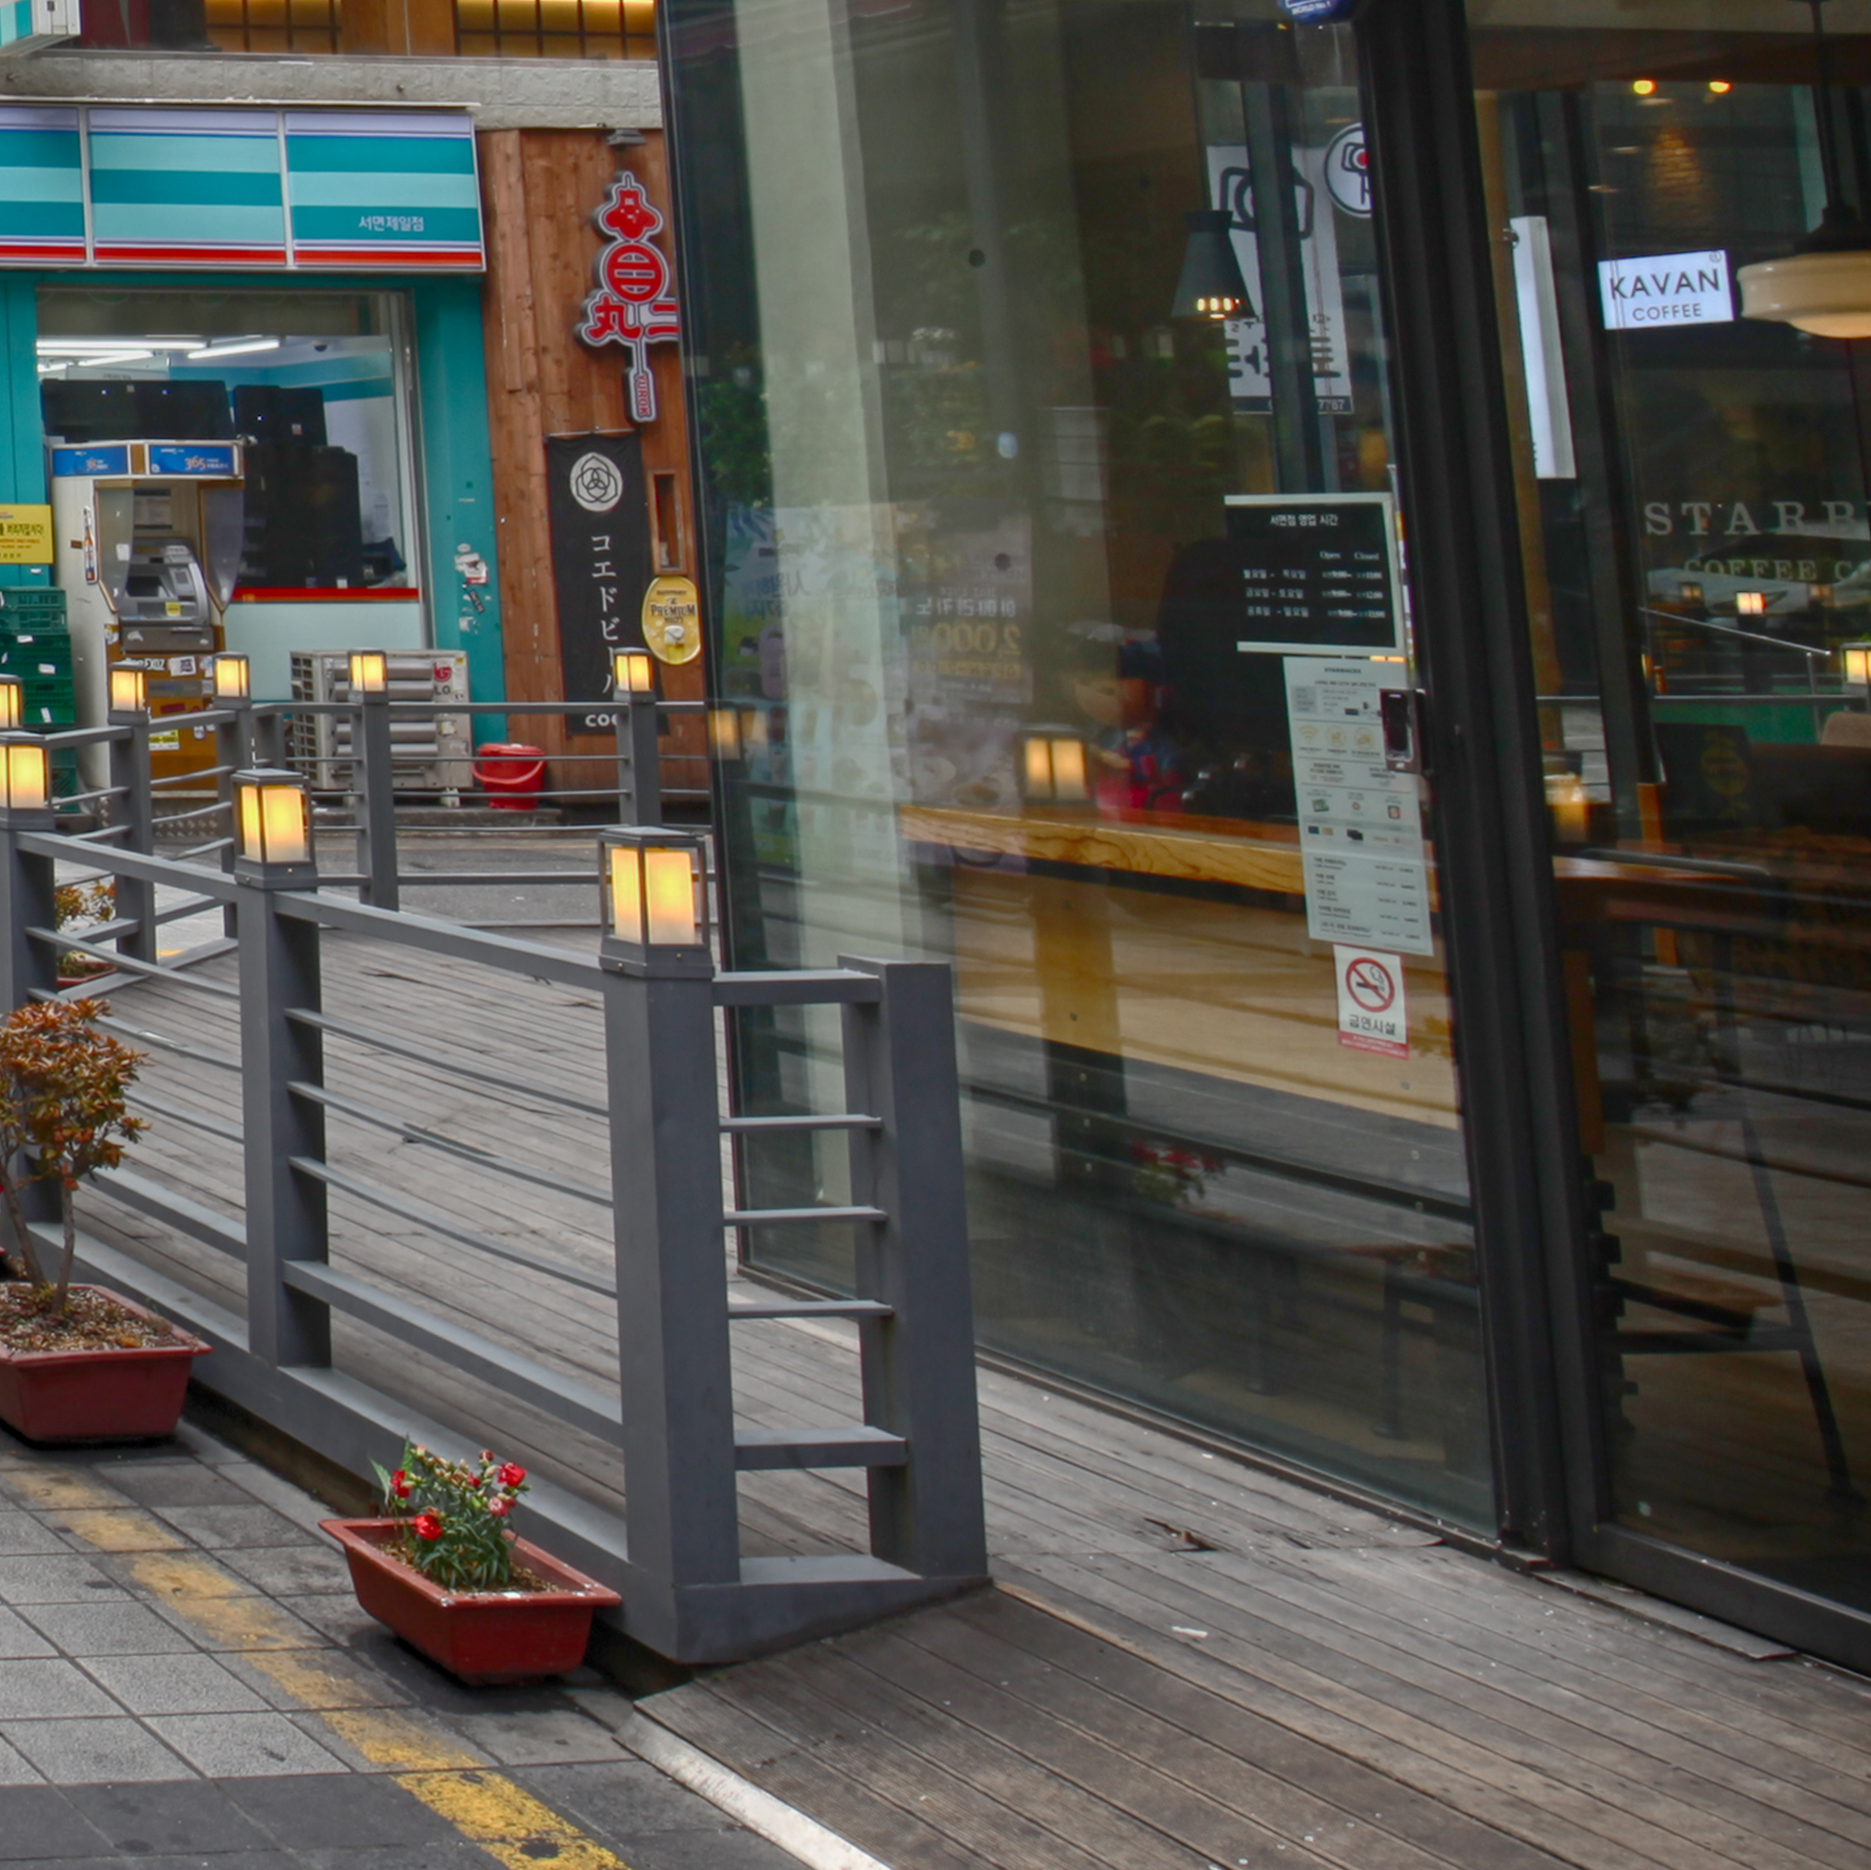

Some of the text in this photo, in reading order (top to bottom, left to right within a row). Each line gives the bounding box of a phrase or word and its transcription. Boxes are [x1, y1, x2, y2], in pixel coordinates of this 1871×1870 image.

[357, 214, 425, 232] 서면제일점
[1609, 267, 1720, 301] KAVAN
[1631, 302, 1703, 323] COFFEE
[636, 374, 651, 415] YUROK
[184, 456, 207, 471] 365
[1270, 513, 1339, 527] 서면점 영업 시간
[1319, 550, 1380, 561] Open Closed
[650, 601, 696, 618] PREMIUM
[1348, 1013, 1396, 1037] 금연시설
